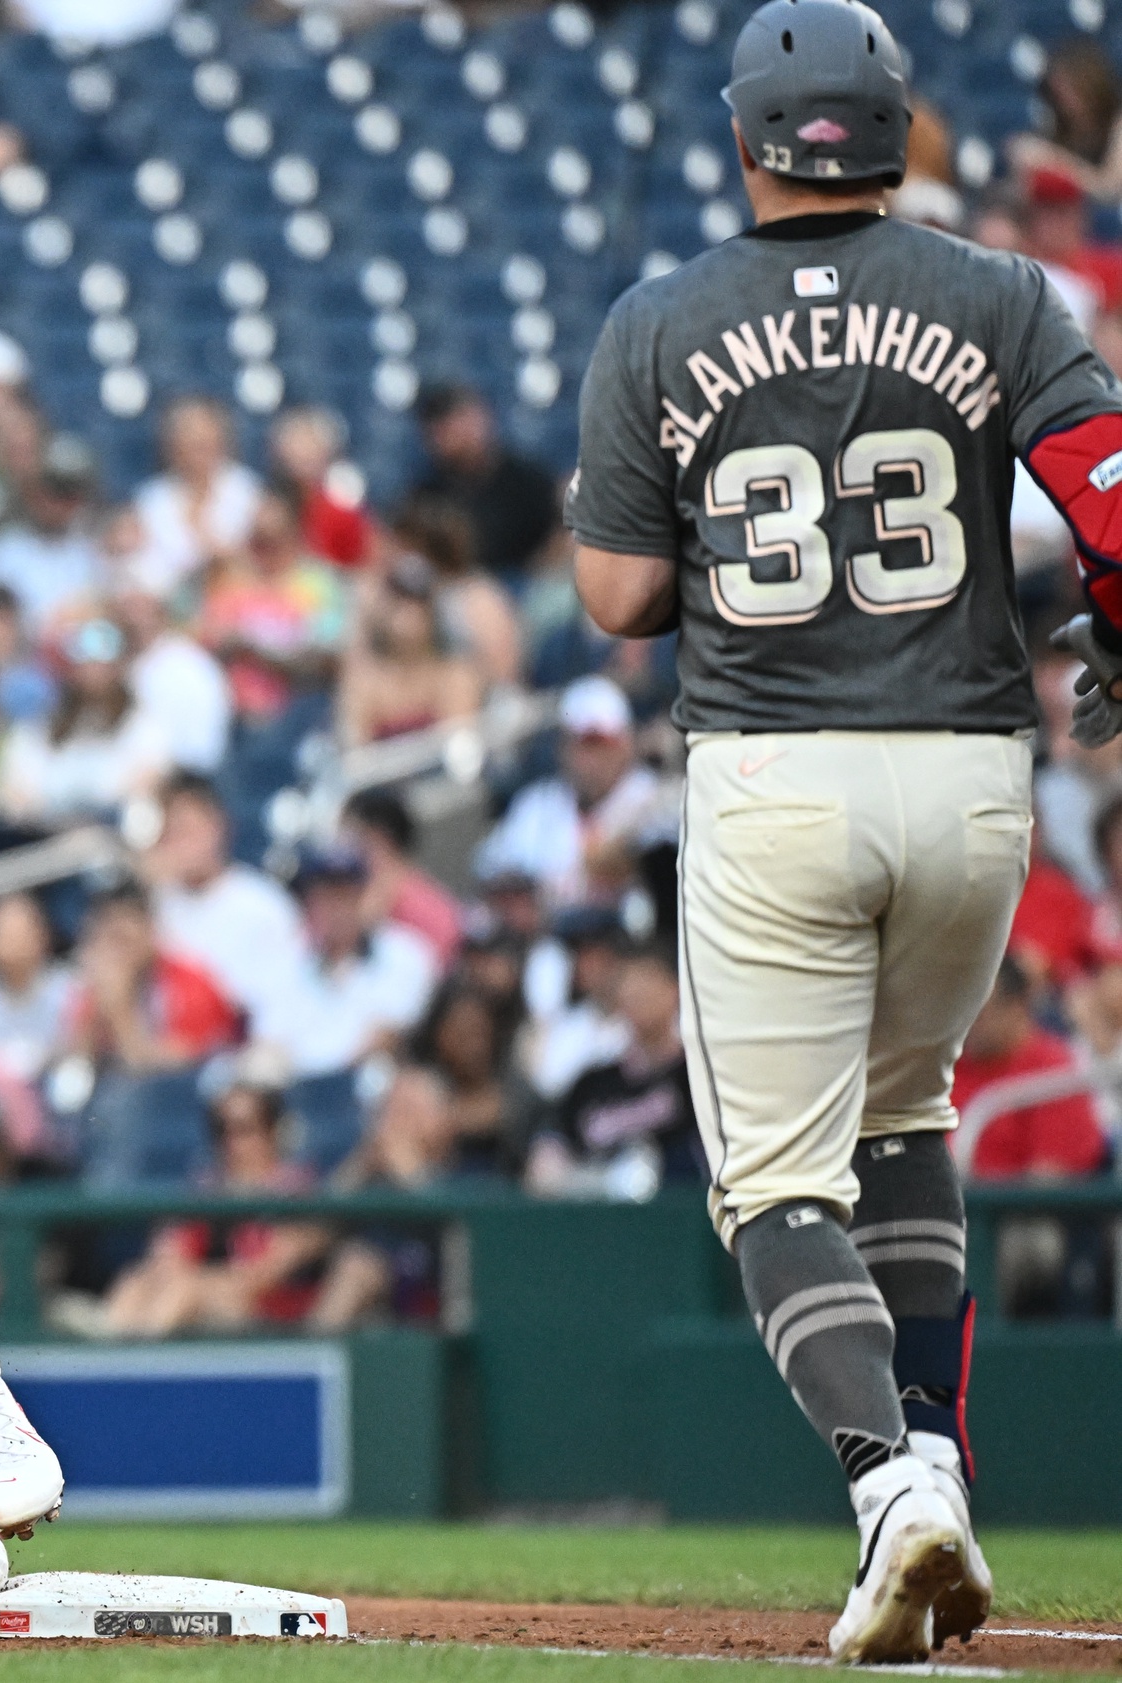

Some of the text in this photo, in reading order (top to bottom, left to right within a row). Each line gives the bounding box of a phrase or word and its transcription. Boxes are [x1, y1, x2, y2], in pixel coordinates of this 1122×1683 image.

[762, 142, 792, 172] 33
[660, 303, 1001, 468] BLANKENHORN
[704, 427, 967, 627] 33
[171, 1614, 219, 1634] WSH
